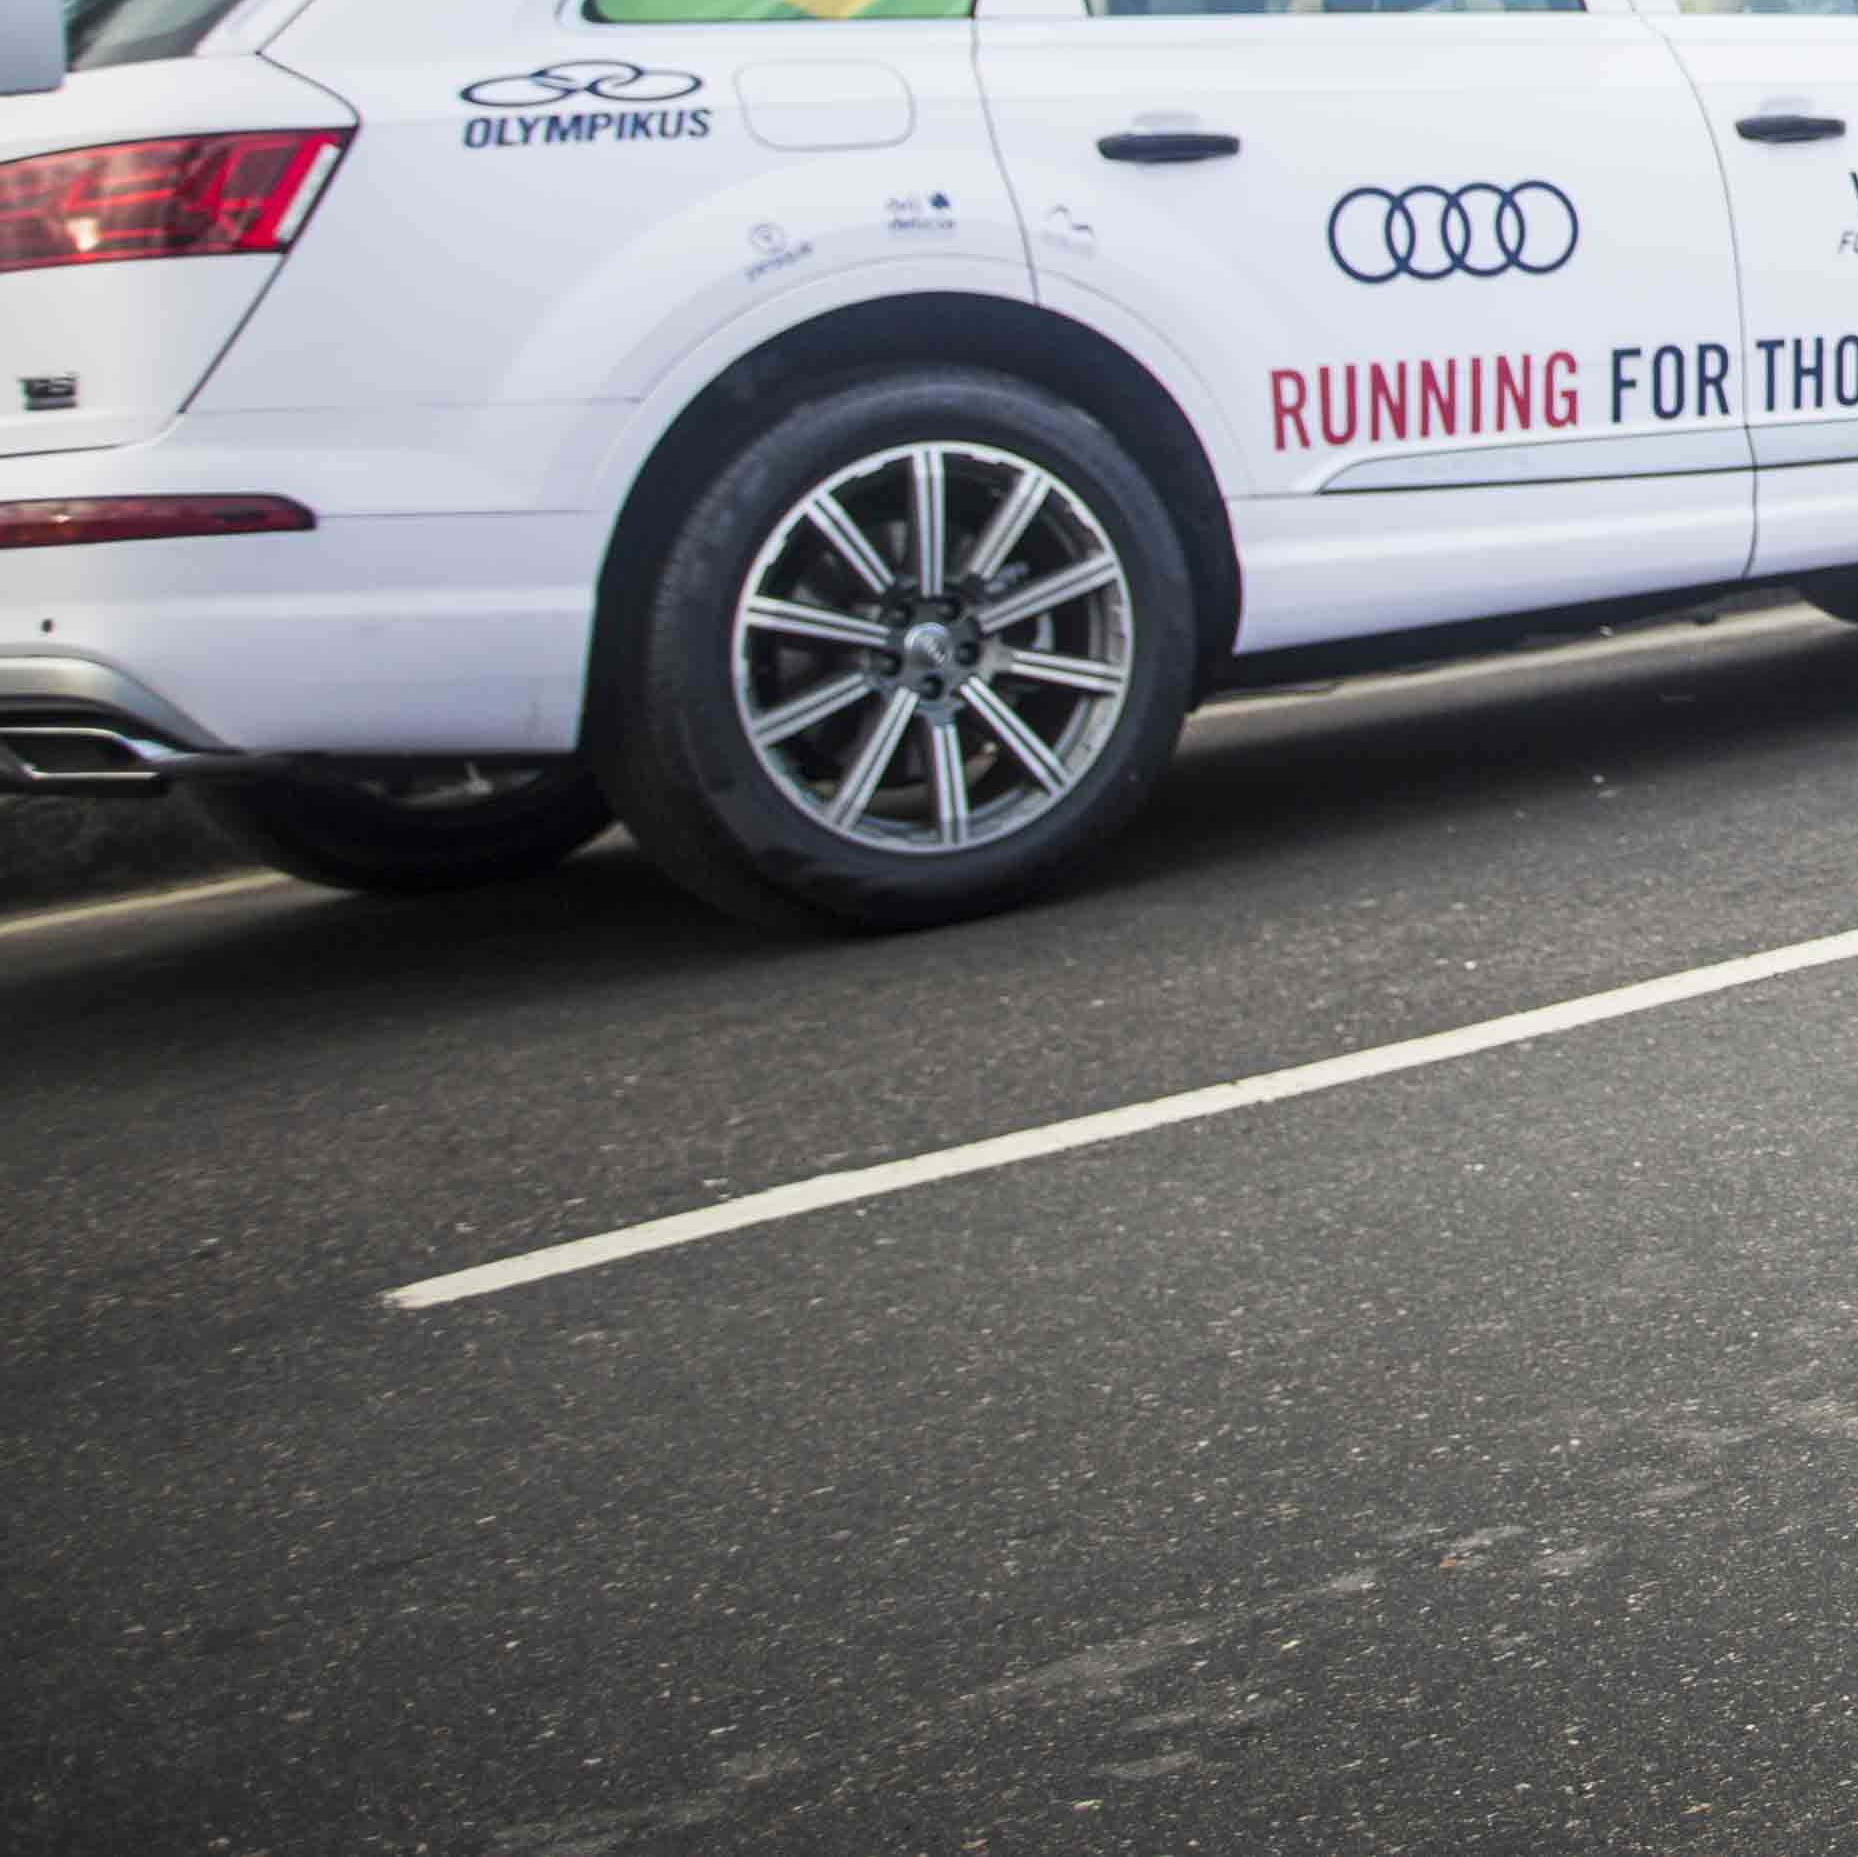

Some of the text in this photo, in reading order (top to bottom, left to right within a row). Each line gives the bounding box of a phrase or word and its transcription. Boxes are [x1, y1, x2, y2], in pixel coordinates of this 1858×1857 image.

[464, 108, 712, 148] OLYMPIKUS
[1270, 351, 1579, 451] RUNNING
[1611, 343, 1730, 424] FOR
